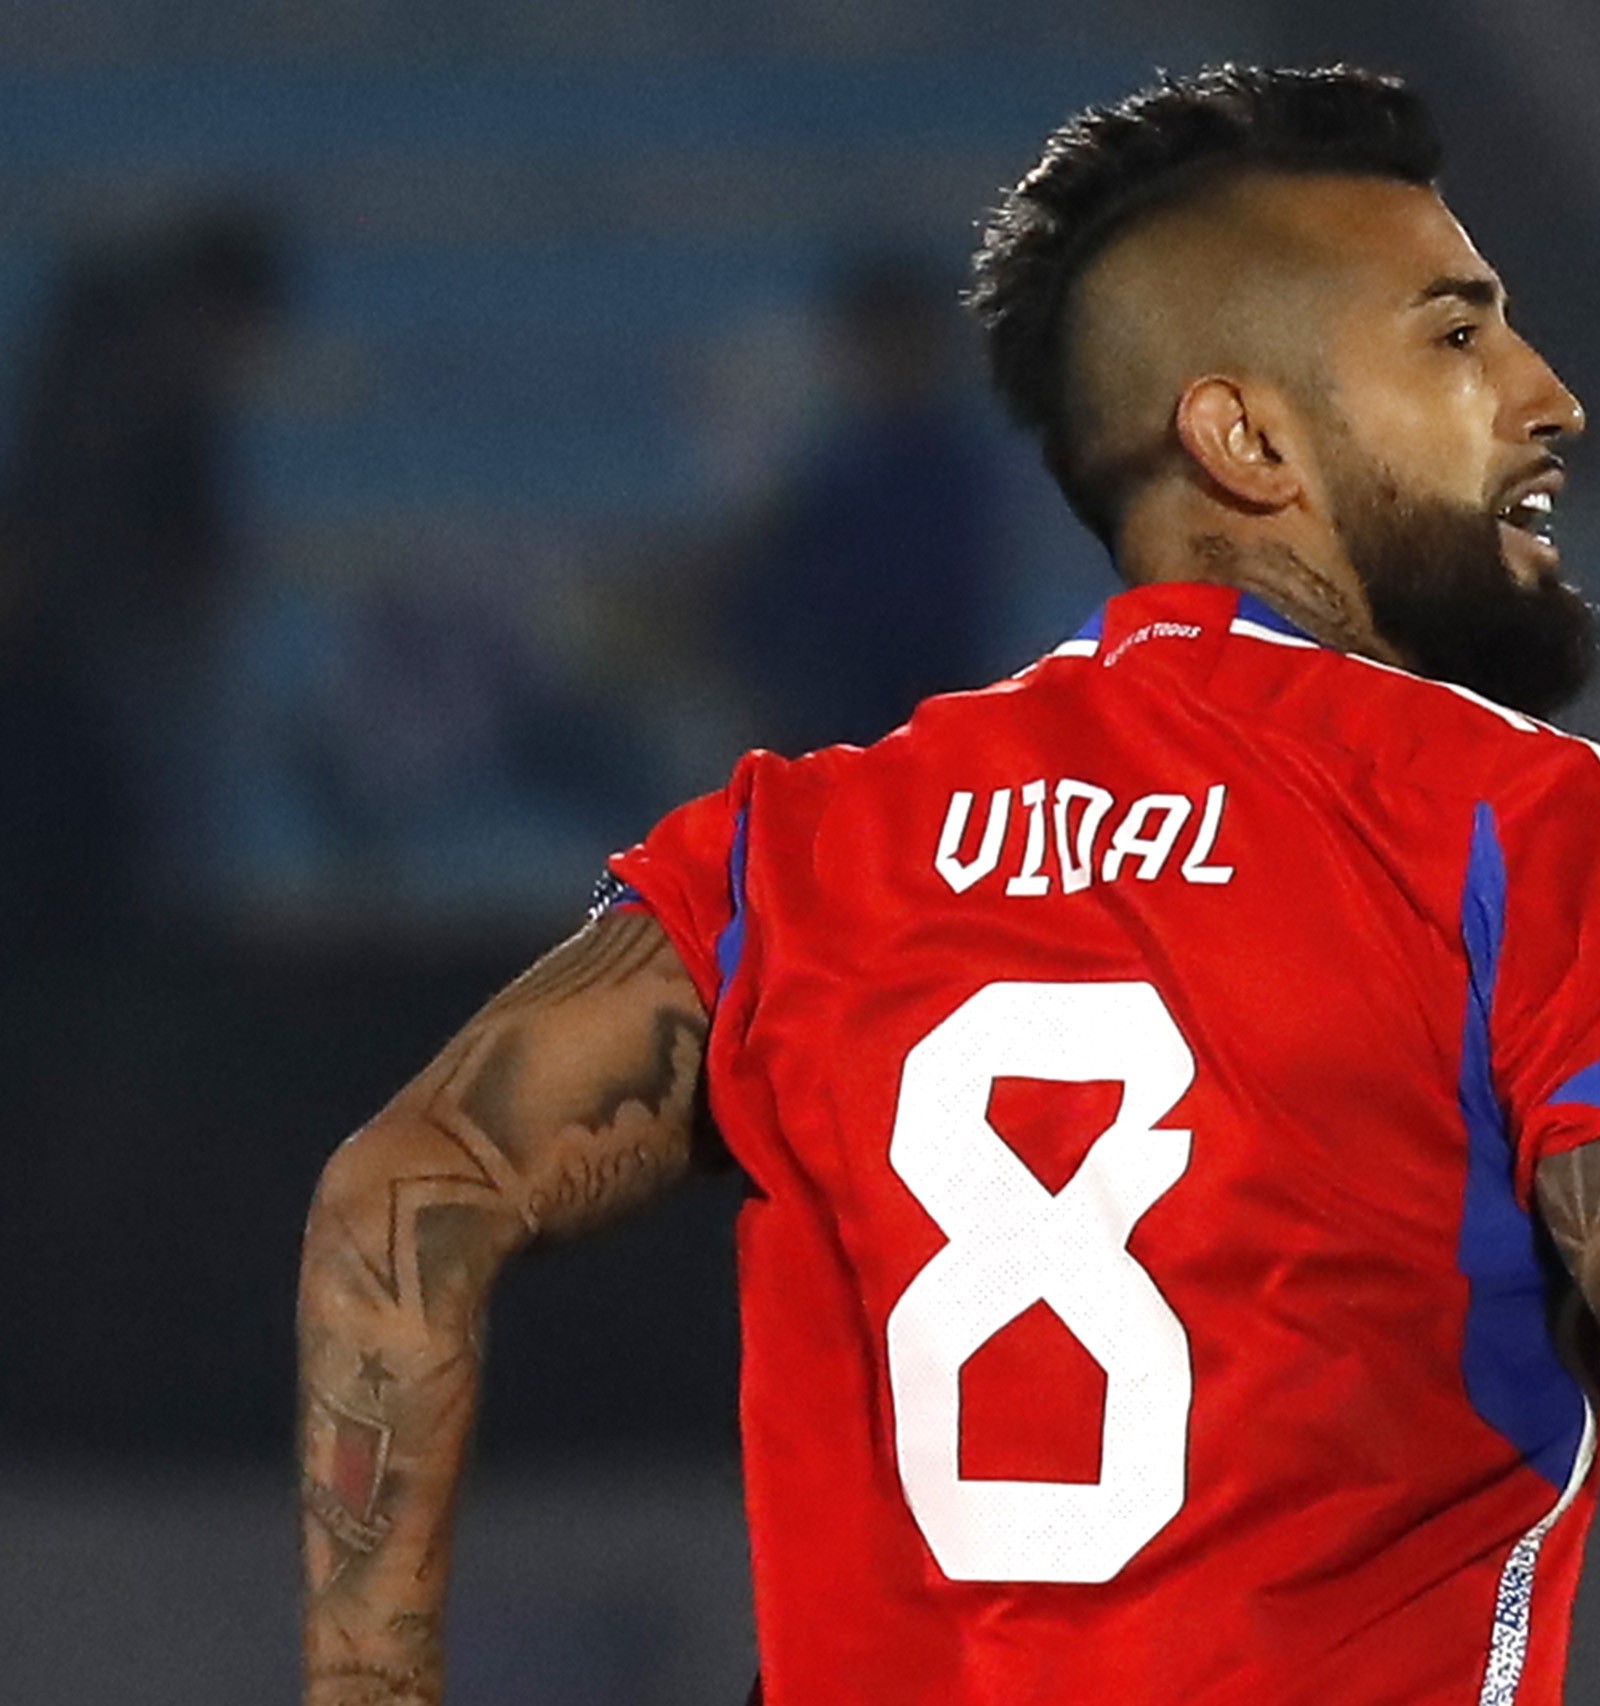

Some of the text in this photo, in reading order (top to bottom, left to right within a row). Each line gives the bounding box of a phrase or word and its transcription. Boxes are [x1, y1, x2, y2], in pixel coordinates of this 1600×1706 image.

[1153, 622, 1201, 638] TODOS
[934, 777, 1236, 896] VIDAL
[886, 980, 1196, 1584] 8
